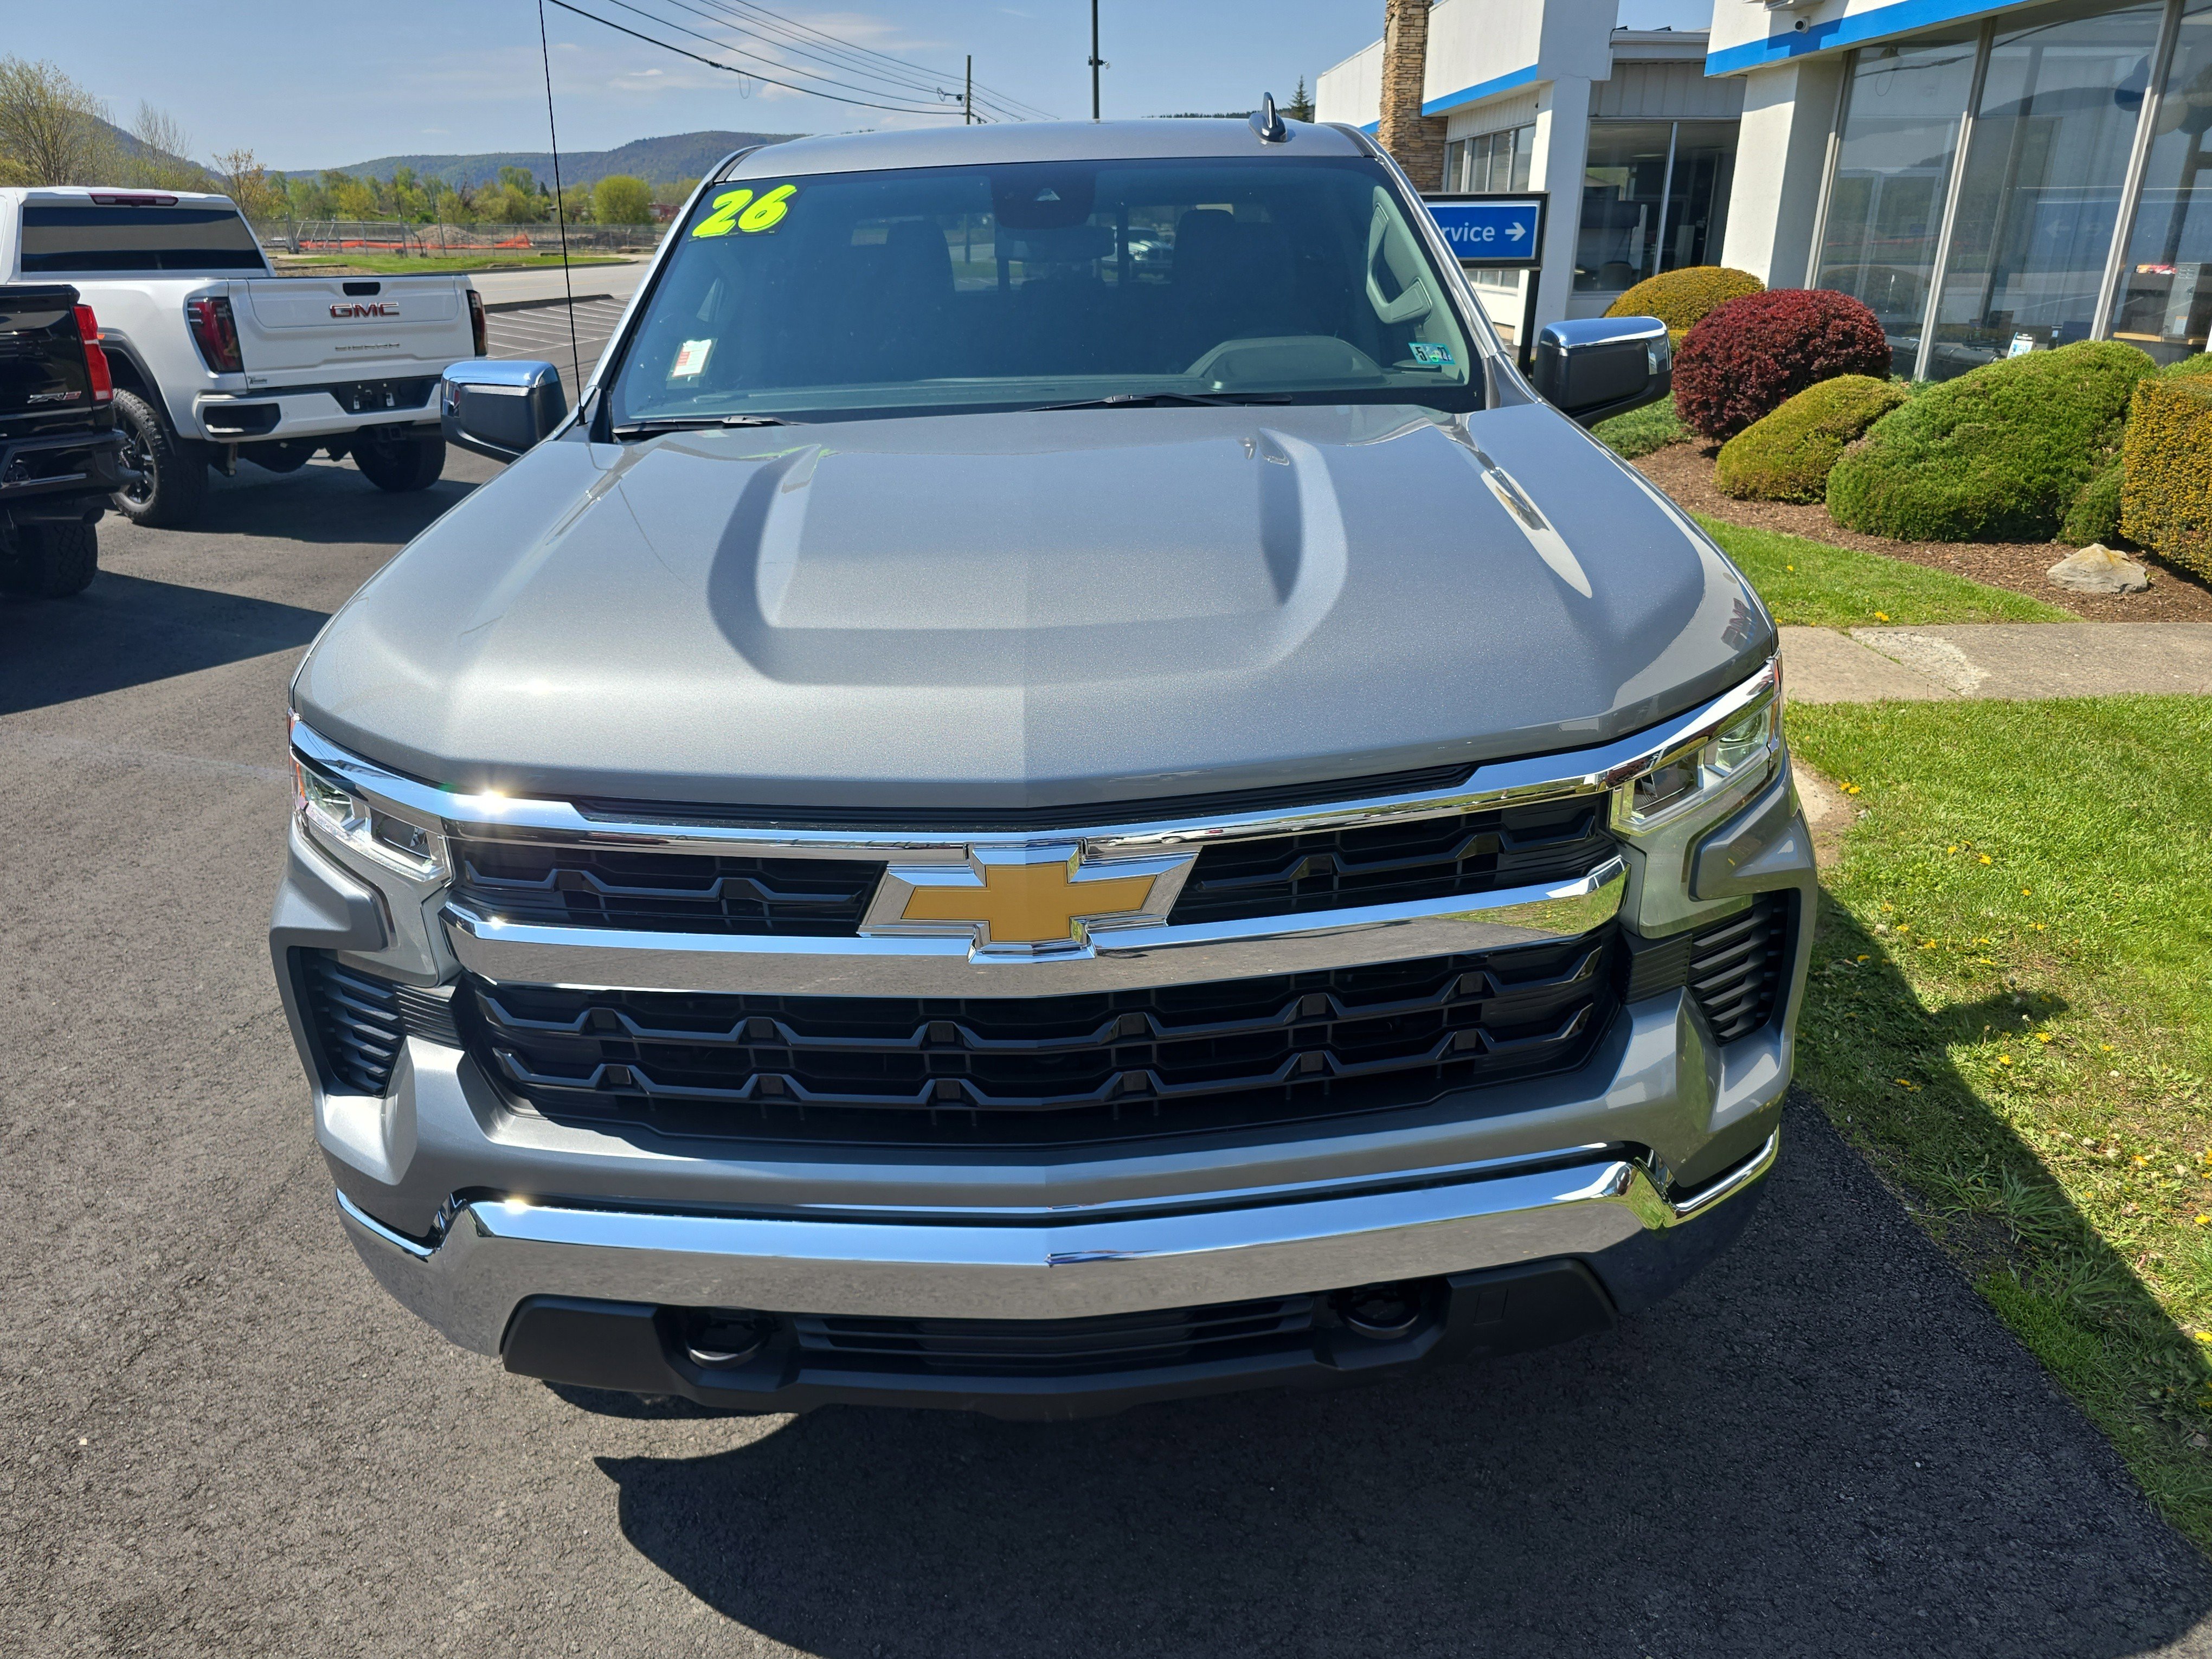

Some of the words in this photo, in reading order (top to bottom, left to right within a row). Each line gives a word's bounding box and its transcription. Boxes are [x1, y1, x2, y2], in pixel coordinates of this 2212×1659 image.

[692, 184, 797, 238] 26
[1442, 222, 1495, 242] rvice
[330, 301, 400, 318] GMC
